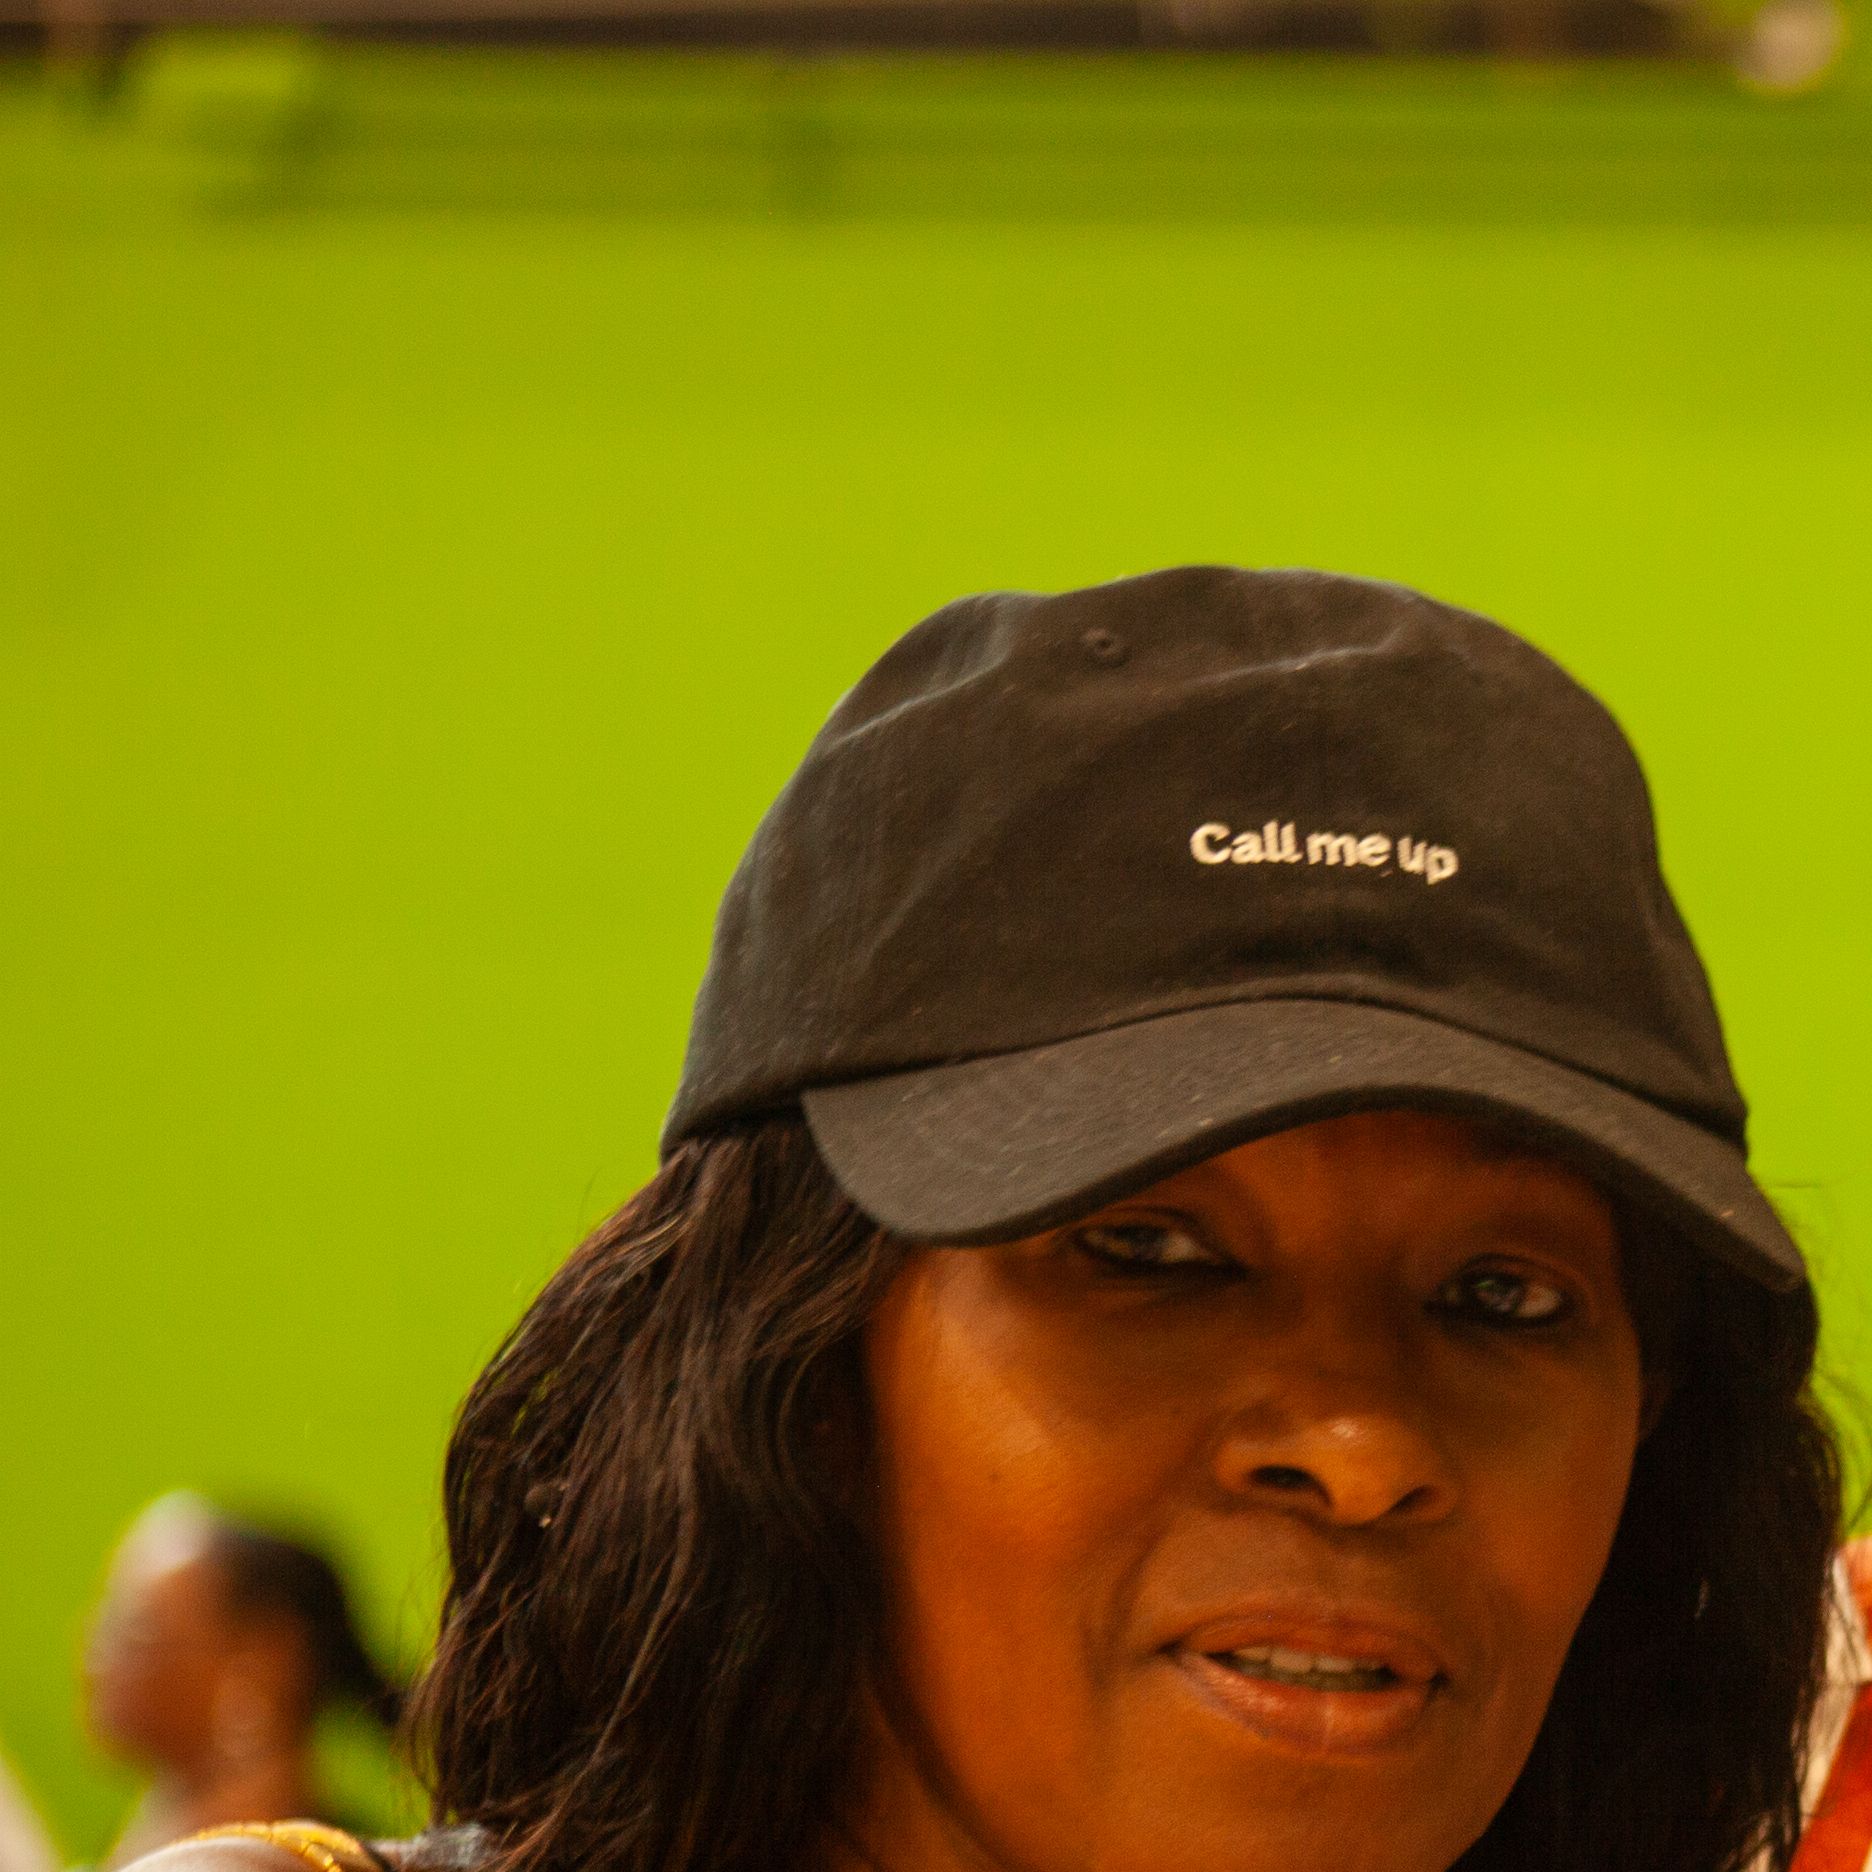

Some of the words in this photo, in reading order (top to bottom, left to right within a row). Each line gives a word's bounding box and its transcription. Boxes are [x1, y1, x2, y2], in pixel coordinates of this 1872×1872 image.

[1190, 818, 1302, 864] Call
[1305, 831, 1391, 867] me
[1397, 835, 1459, 885] up
